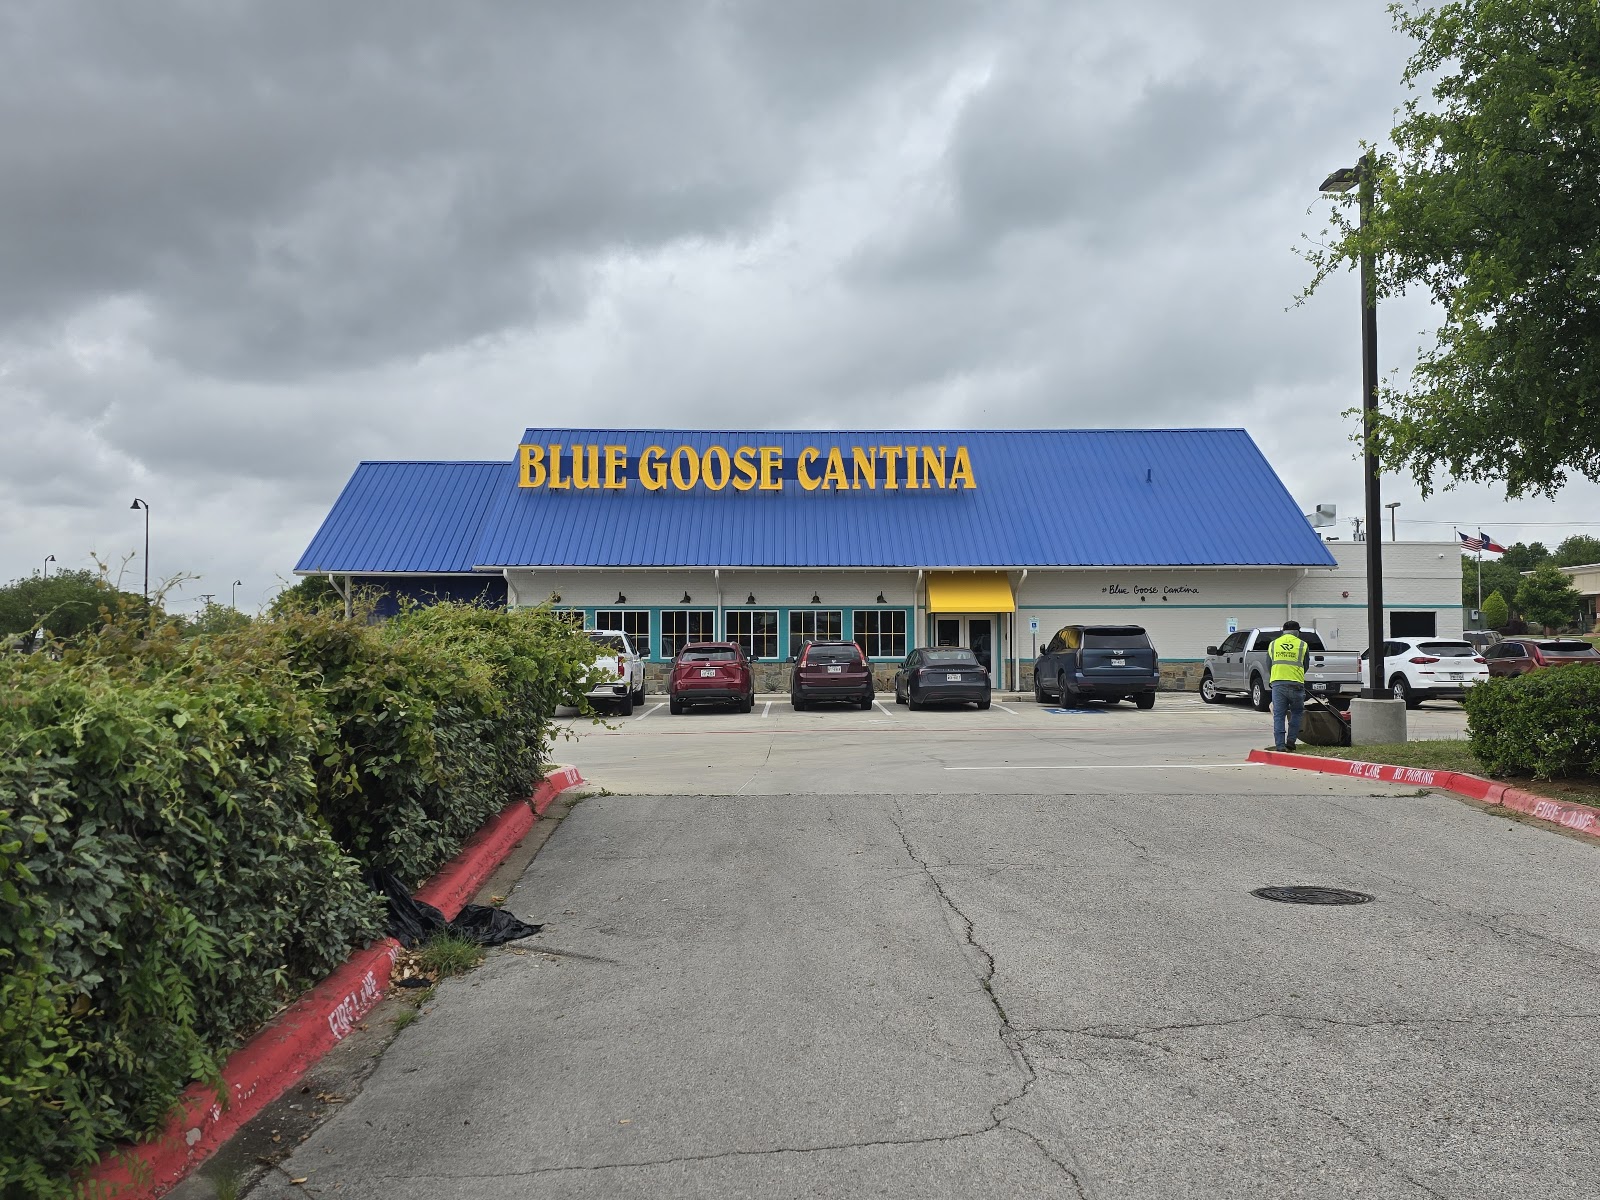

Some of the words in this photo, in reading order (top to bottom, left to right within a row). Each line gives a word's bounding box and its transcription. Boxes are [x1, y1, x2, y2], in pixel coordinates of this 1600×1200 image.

[517, 443, 627, 490] BLUE
[638, 444, 783, 491] GOOSE
[797, 444, 977, 491] CANTINA
[1133, 585, 1159, 595] Goose
[1163, 584, 1200, 594] Cantina
[1349, 762, 1365, 775] FIRE
[1364, 764, 1383, 779] LANE
[1392, 767, 1405, 780] NO
[1404, 769, 1435, 785] PARKING
[1532, 801, 1562, 821] FIRE
[1561, 811, 1596, 830] LANE
[328, 995, 353, 1040] FIRE
